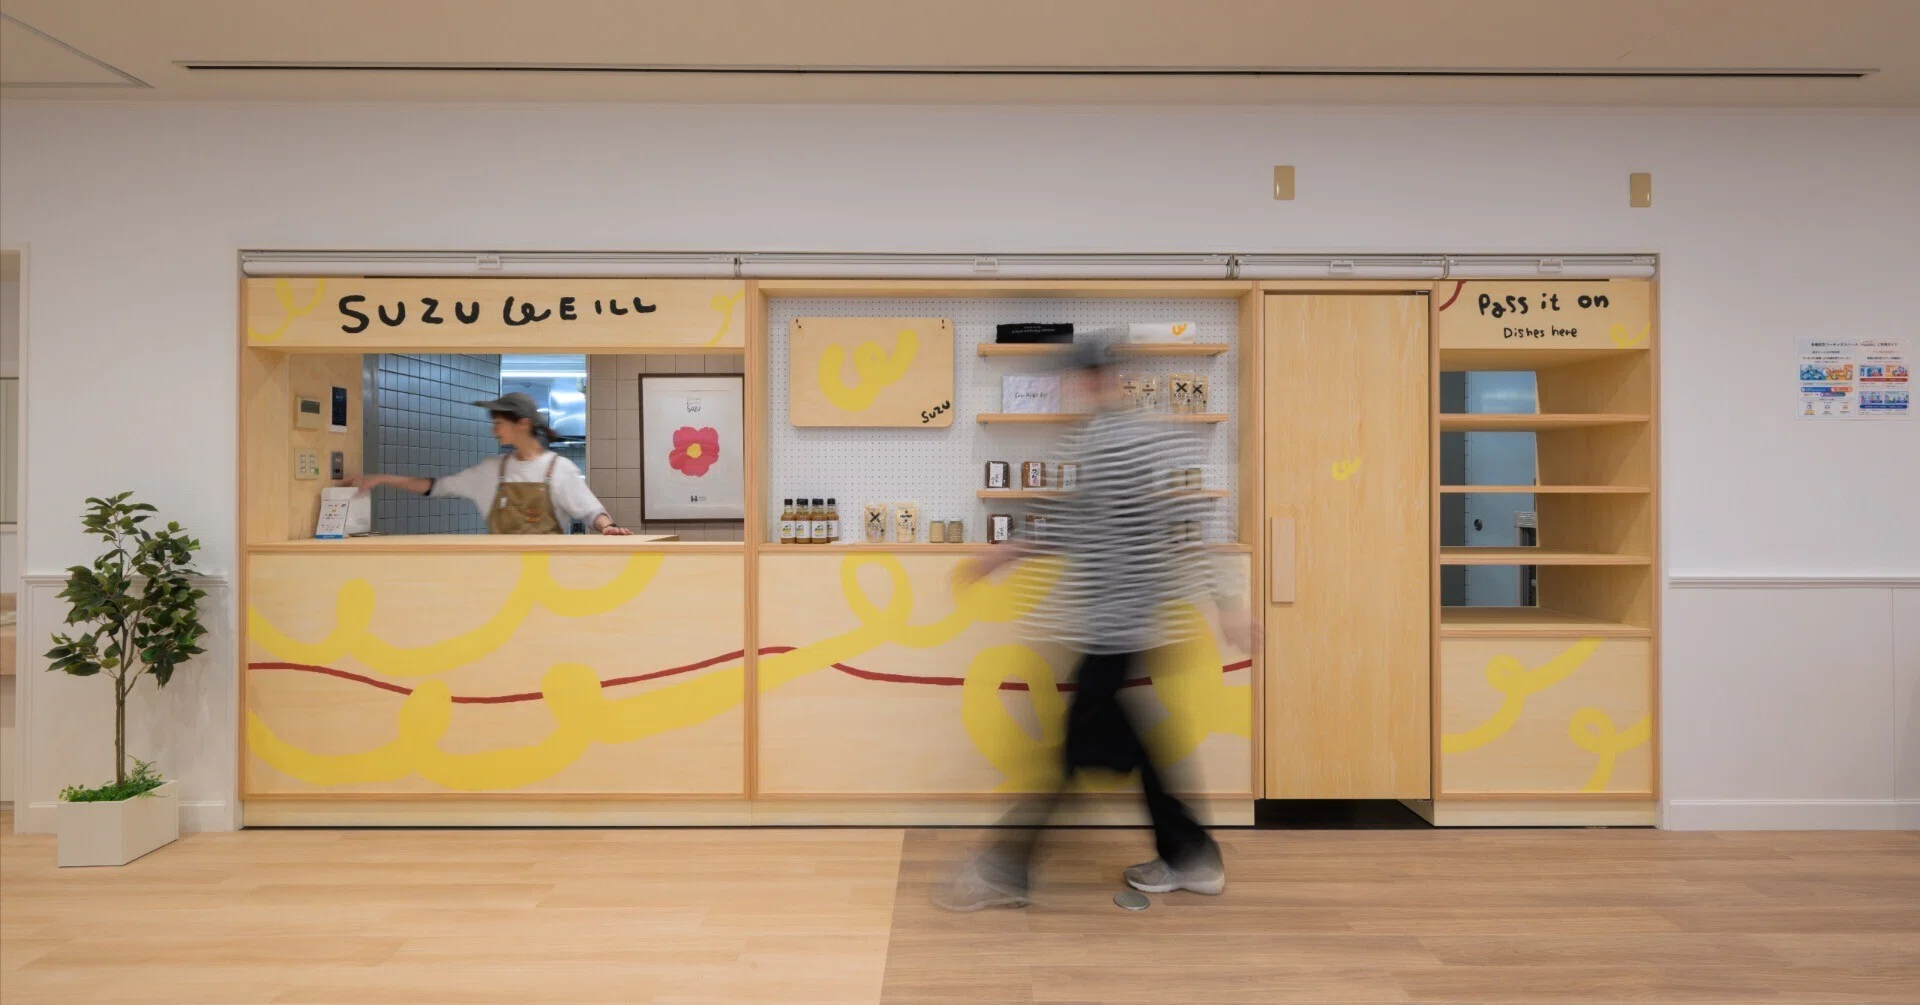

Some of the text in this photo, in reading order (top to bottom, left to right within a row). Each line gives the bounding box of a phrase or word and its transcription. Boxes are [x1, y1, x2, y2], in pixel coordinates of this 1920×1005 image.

[338, 295, 480, 334] SUZU
[1478, 292, 1610, 319] Pass it on
[1503, 324, 1578, 339] Dishes here
